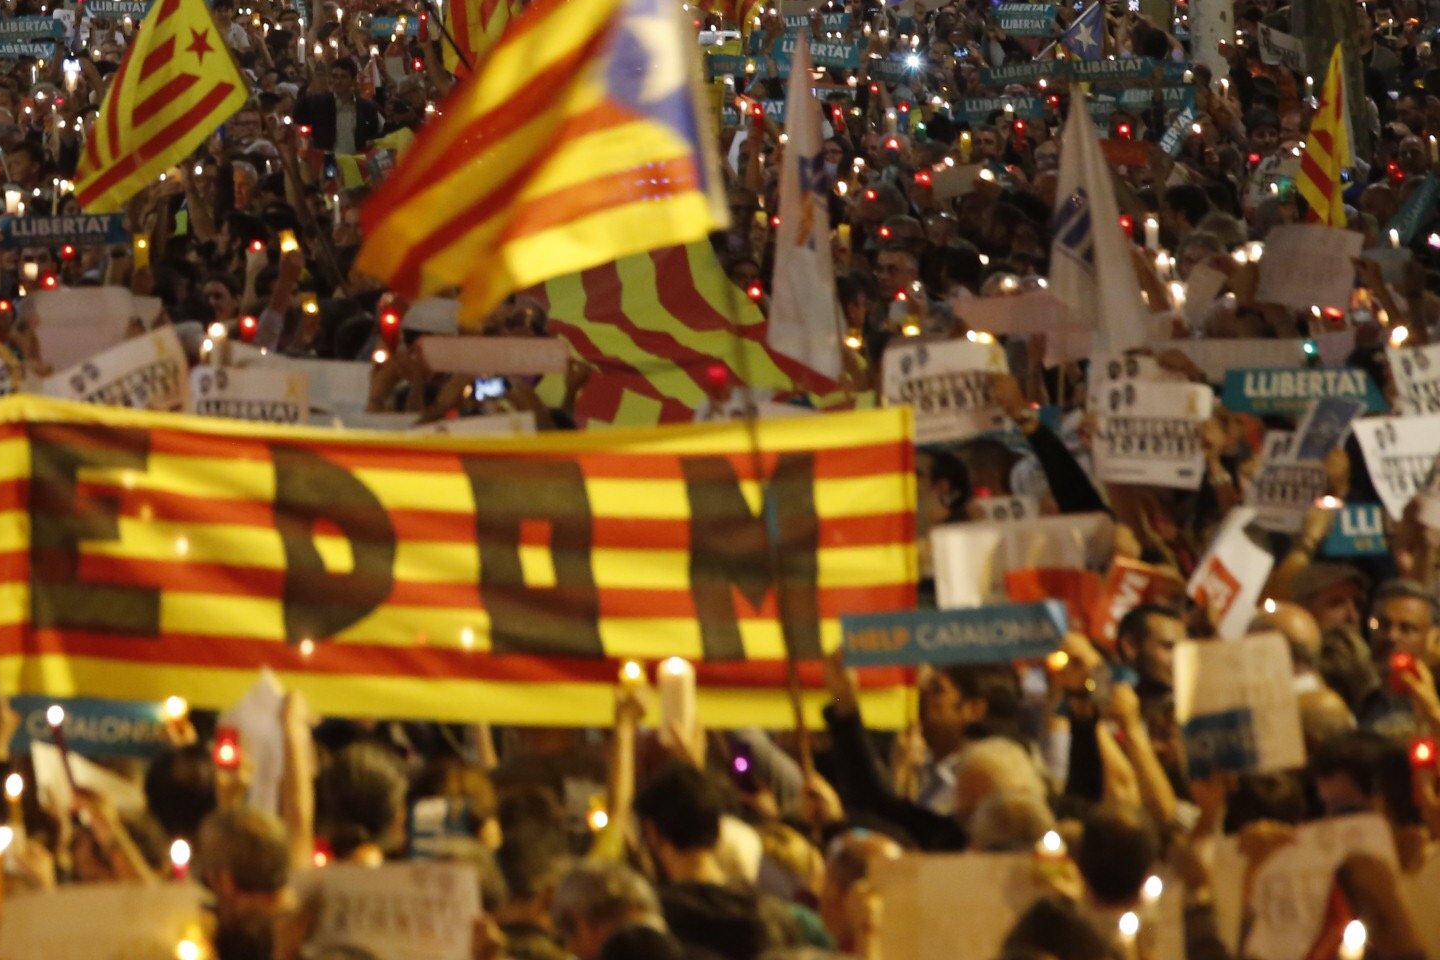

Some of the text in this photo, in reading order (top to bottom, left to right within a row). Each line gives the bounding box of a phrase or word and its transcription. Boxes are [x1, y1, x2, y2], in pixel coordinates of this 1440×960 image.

[90, 1, 147, 12] LLIBERTAT
[1001, 18, 1047, 30] LLIBERTAT
[990, 63, 1055, 80] LLIBERTAT
[1072, 57, 1143, 74] LLIBERTAT
[12, 216, 110, 237] LLIBERTAT
[1244, 370, 1368, 398] LLIBERTAT
[846, 618, 1057, 652] HELP CATALONIA
